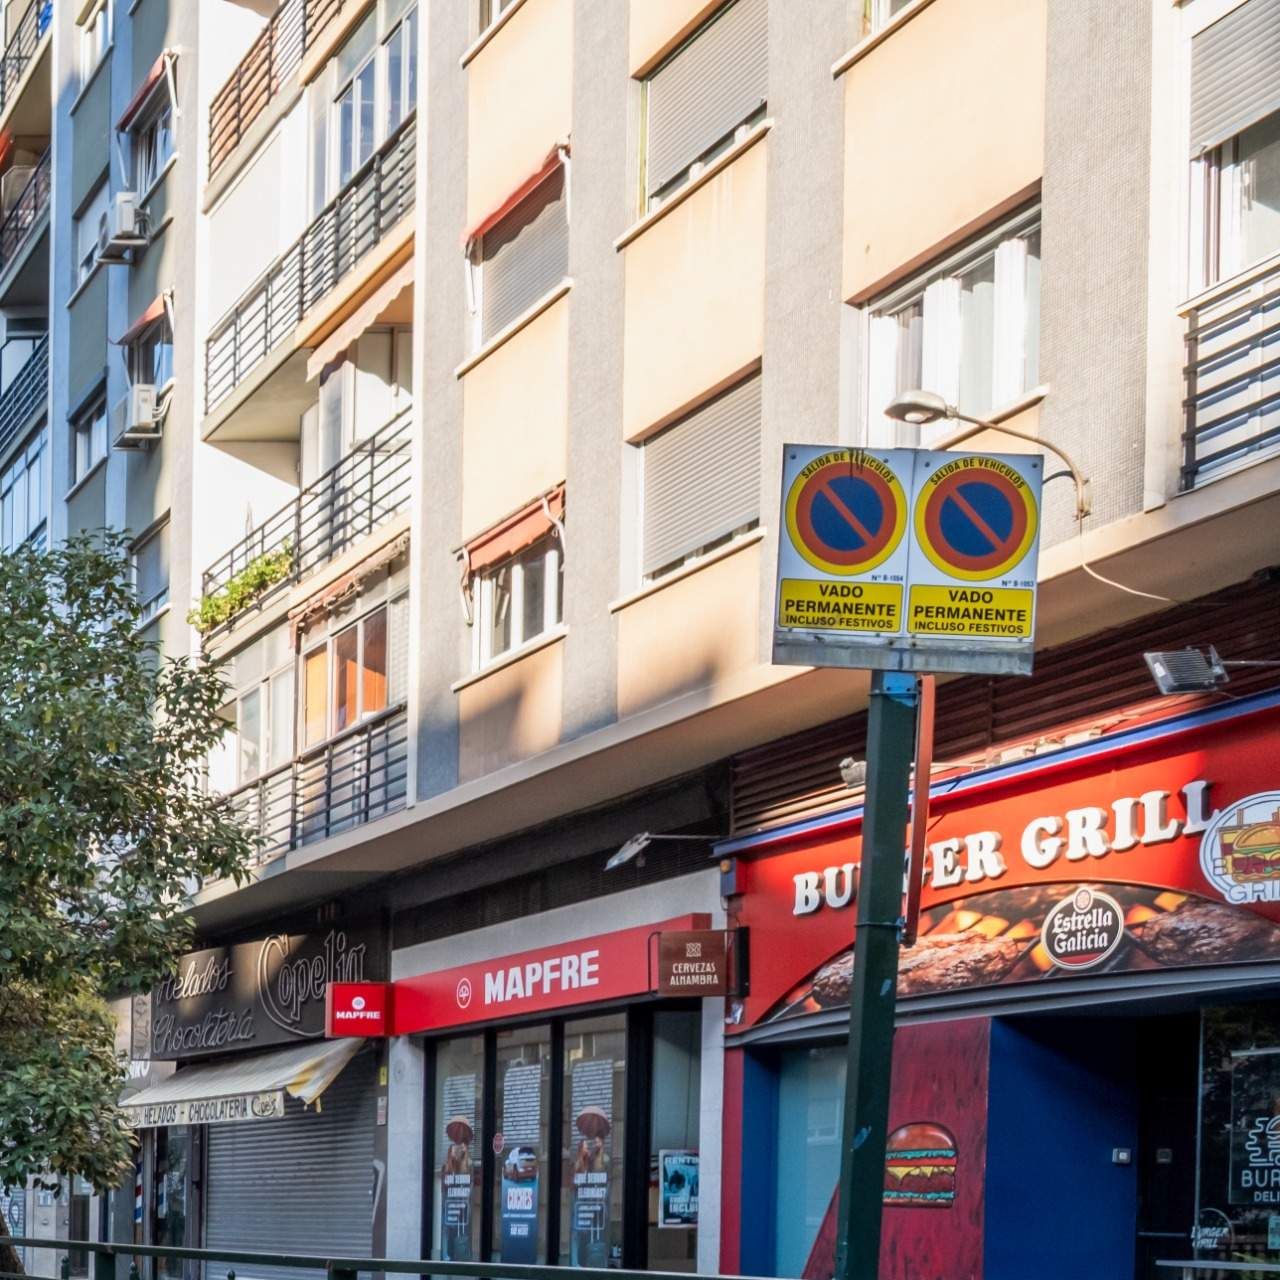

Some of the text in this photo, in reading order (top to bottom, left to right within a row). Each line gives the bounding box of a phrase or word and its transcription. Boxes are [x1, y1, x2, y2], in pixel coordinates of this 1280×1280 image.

[801, 455, 831, 479] SALIDA
[833, 453, 845, 462] DE
[930, 458, 1025, 489] SALIDA DE VEHICULOS
[819, 584, 863, 598] VADO
[948, 590, 994, 604] VADO
[785, 599, 896, 616] PERMANENTE
[914, 605, 1026, 622] PERMANENTE
[785, 615, 894, 628] INCLUSO FESTIVOS
[914, 621, 1024, 634] INCLUSO FESTIVOS
[793, 780, 1221, 916] BUER GRILL
[1051, 908, 1113, 934] Estrella
[1054, 928, 1108, 954] Galicia
[672, 961, 716, 974] CERVEZAS
[484, 949, 600, 1005] MAPFRE
[670, 974, 719, 986] ALHAMBRA
[335, 1011, 381, 1019] MAPFRE
[144, 1104, 177, 1125] HELADOS
[189, 1097, 248, 1122] CHOCOLATERIA
[1254, 1191, 1280, 1202] DELI
